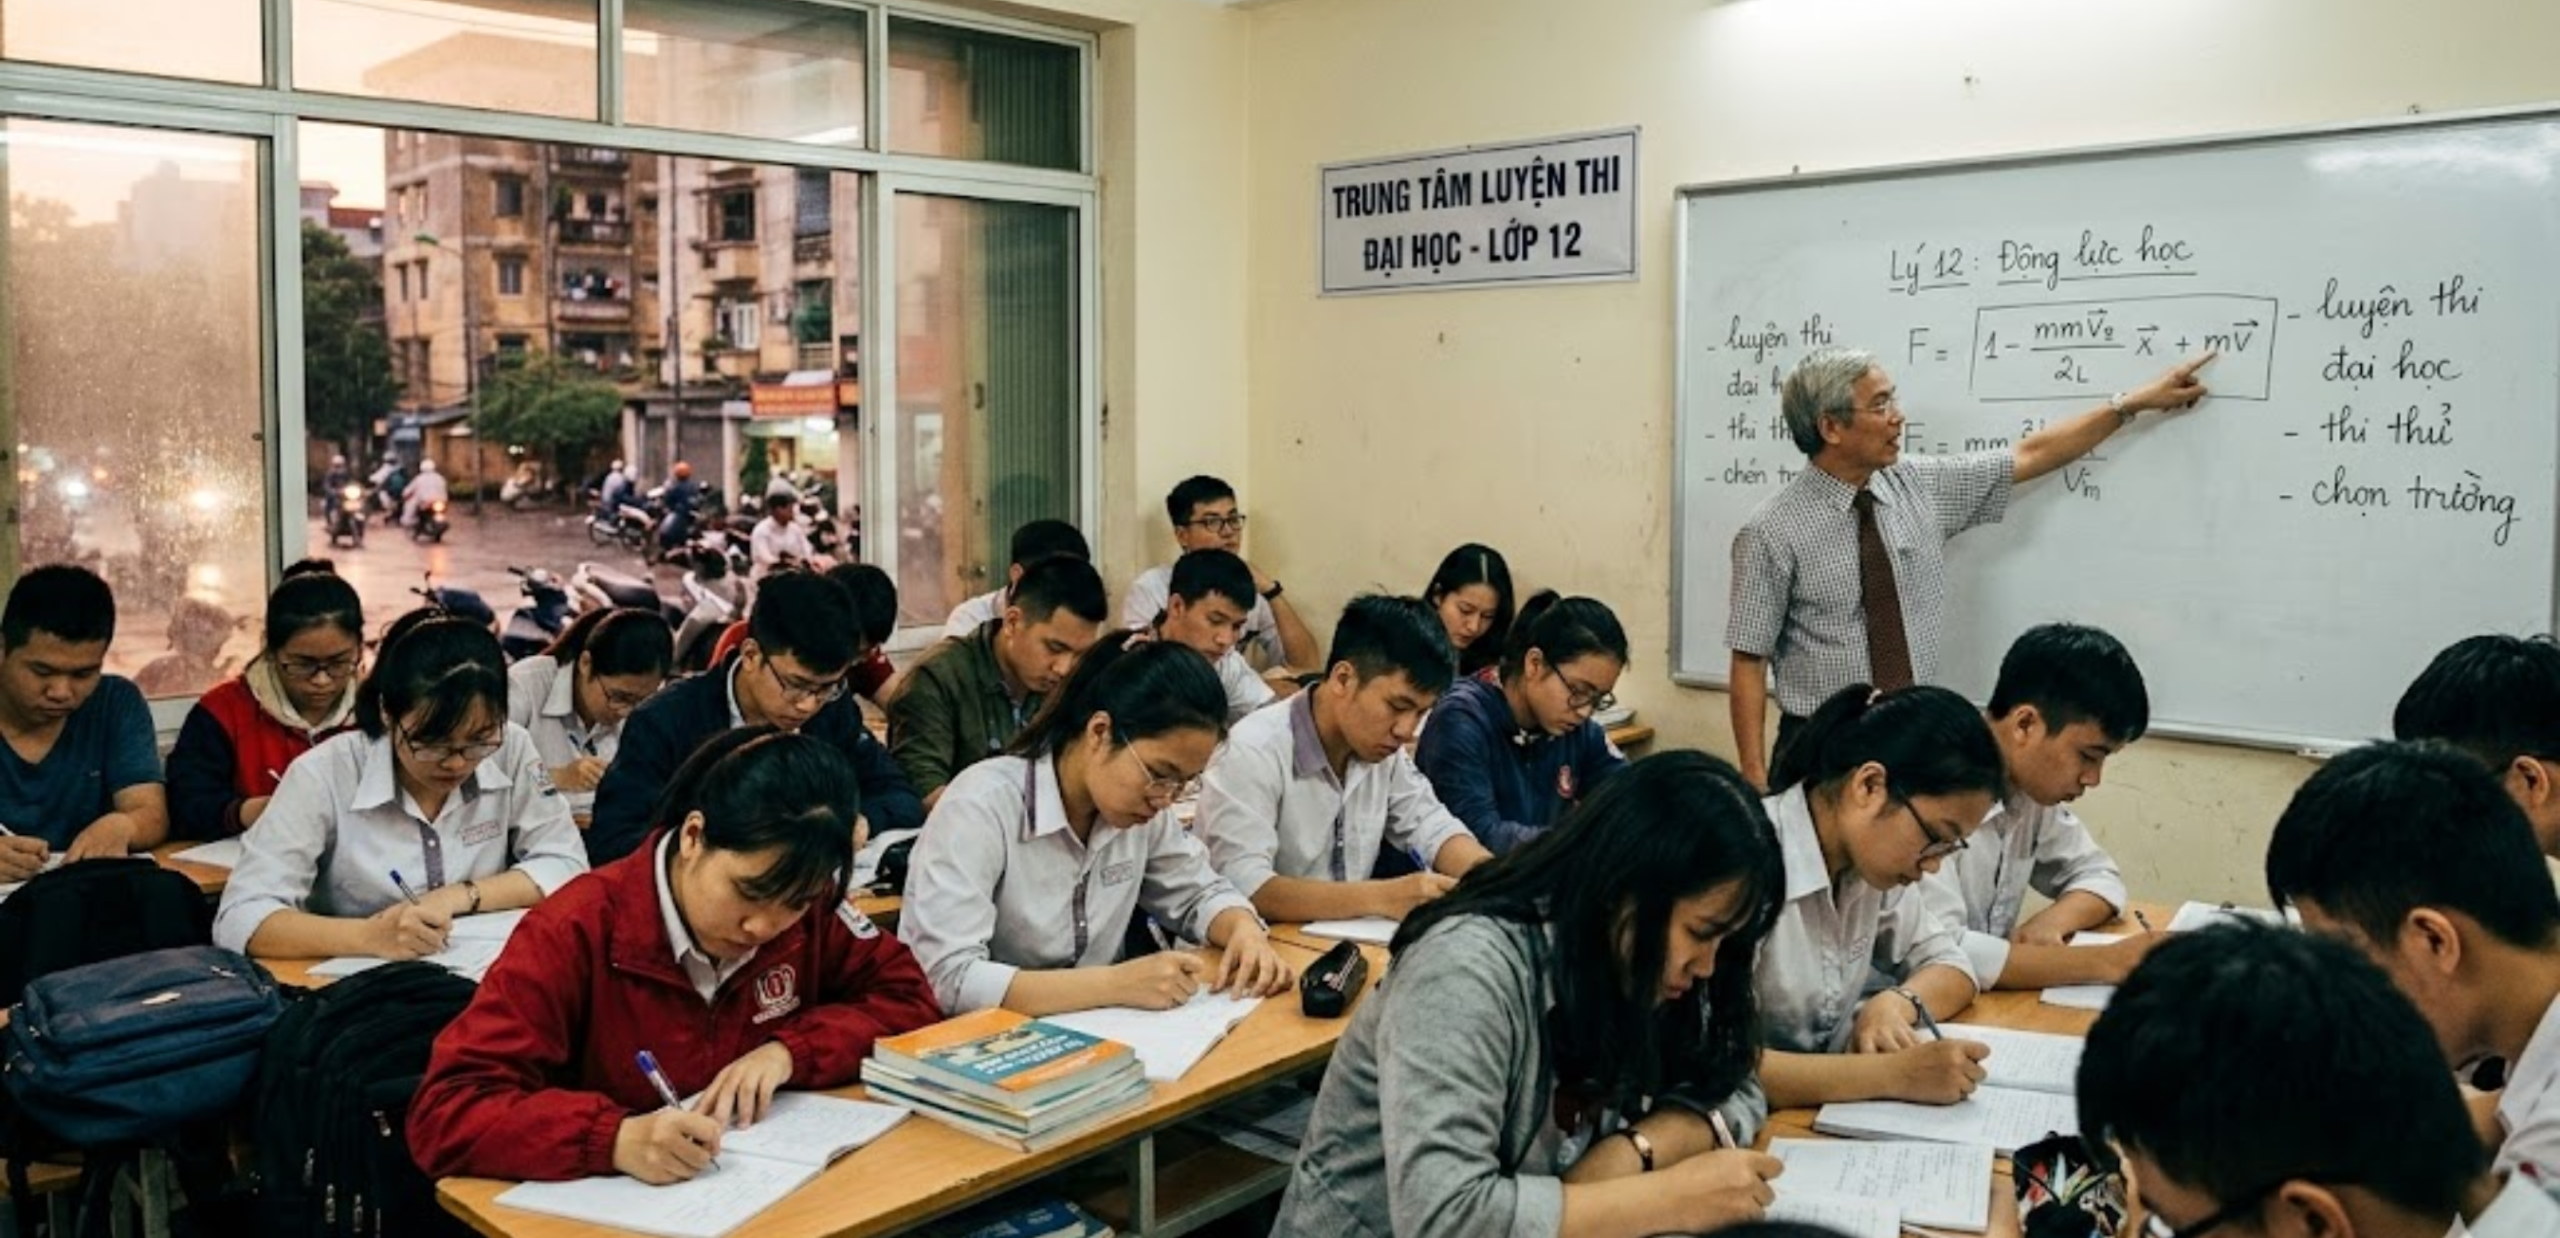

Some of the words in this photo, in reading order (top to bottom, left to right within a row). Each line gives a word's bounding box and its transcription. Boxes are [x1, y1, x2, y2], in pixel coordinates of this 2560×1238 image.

[1333, 179, 1410, 218] TRUNG
[1419, 168, 1472, 210] TÂM
[1481, 155, 1566, 208] LUYỆN
[1575, 155, 1620, 196] THI
[1363, 237, 1403, 278] ĐẠI
[1412, 232, 1461, 274] HỌC
[1488, 217, 1538, 264] LỚP
[1549, 222, 1582, 259] 12
[1890, 242, 1926, 295] Lý
[1997, 239, 2059, 290] Động
[2074, 229, 2122, 273] lực
[2136, 224, 2194, 270] học
[2317, 277, 2413, 338] luyện
[2430, 275, 2484, 316] thi
[1724, 314, 1788, 364] luyện
[1799, 313, 1833, 346] thi
[1909, 328, 1929, 365] F
[2322, 345, 2376, 391] đại
[2391, 340, 2463, 390] học
[1728, 412, 1756, 440] thi
[2320, 405, 2369, 443] thi
[2312, 465, 2390, 517] chọn
